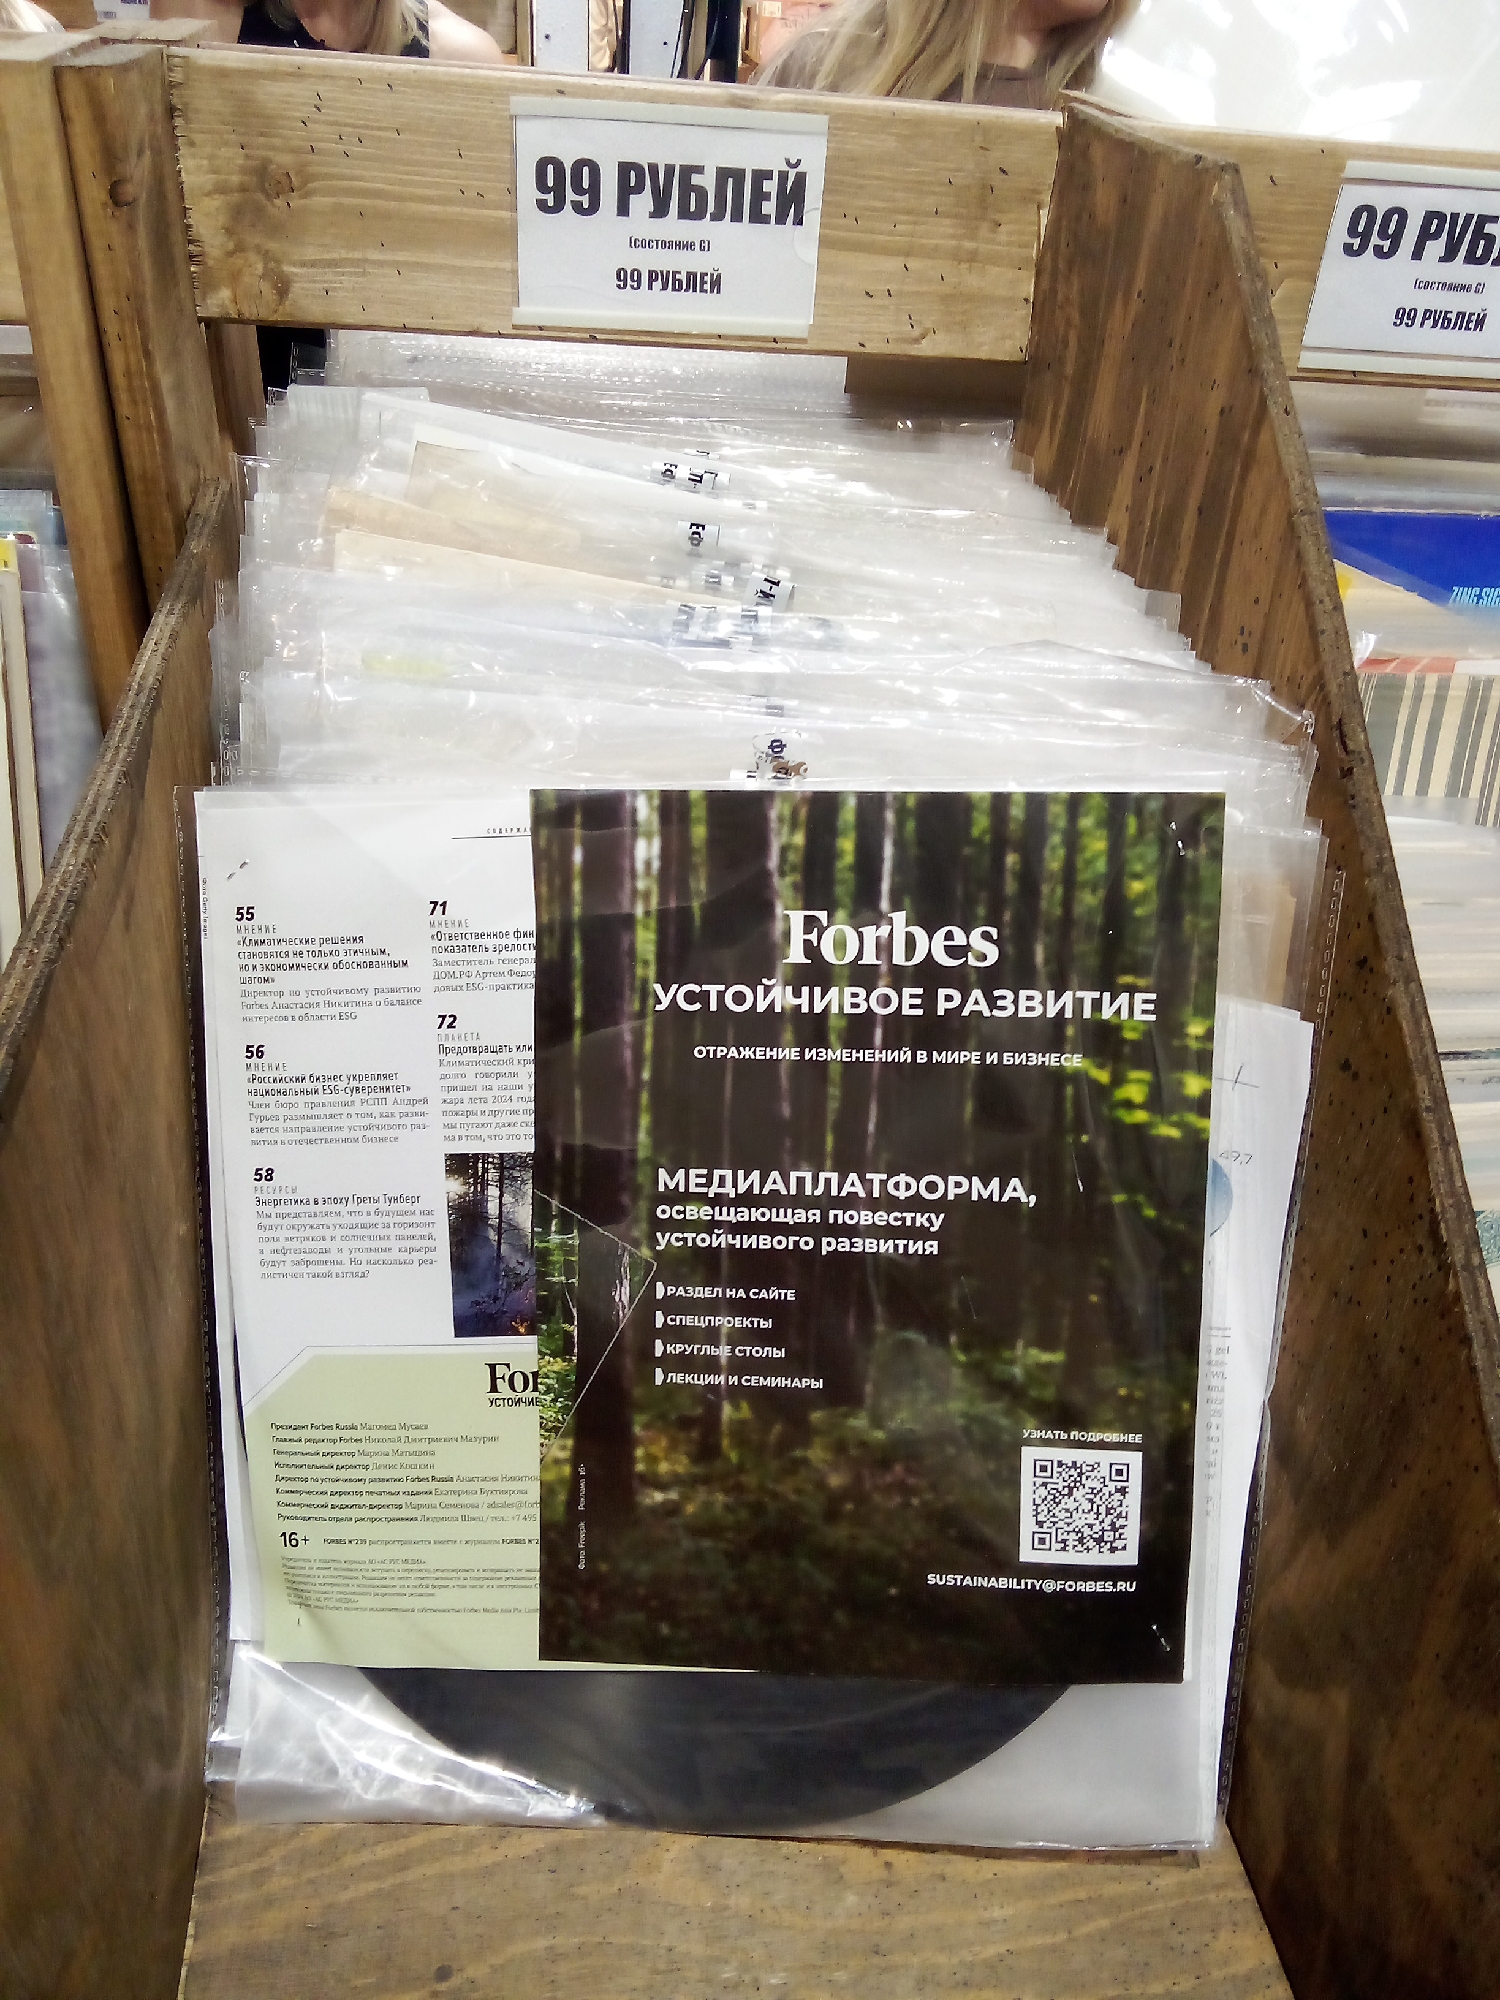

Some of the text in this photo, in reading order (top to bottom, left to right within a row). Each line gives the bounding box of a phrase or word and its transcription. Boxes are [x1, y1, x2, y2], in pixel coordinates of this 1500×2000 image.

[534, 155, 808, 227] 99 РУБЛЕЙ
[1342, 204, 1500, 267] 99 РУБ
[615, 267, 722, 295] 99 РУБЛЕЙ
[1392, 307, 1487, 332] 99 РУБЛЕЙ
[486, 827, 531, 835] СОДЕРЖА
[235, 906, 255, 922] 55
[428, 900, 448, 916] 71
[236, 924, 277, 934] МНЕНИЕ
[429, 918, 469, 929] МНЕНИЕ
[237, 934, 364, 949] «Климатические решения
[430, 929, 510, 942] «Ответственное
[782, 909, 1001, 969] Forbes
[237, 948, 390, 960] становятся не только этичным,
[431, 944, 489, 954] показатель
[238, 959, 409, 972] но и экономически обоснованным
[432, 958, 494, 967] Заместитель
[239, 975, 275, 985] шагом»
[433, 971, 473, 980] ДОМ.РФ
[475, 970, 506, 981] Артем
[240, 985, 422, 999] Директор по устойчивому развитию
[433, 985, 464, 993] довых
[241, 1001, 269, 1010] Forbes
[271, 1001, 320, 1010] Анастасия
[323, 999, 373, 1008] Никитина
[383, 997, 422, 1006] балансе
[652, 978, 1158, 1022] УСТОЙЧИВОЕ РАЗВИТИЕ
[242, 1014, 289, 1024] интересов
[298, 1012, 337, 1022] области
[338, 1011, 358, 1020] ESG
[437, 1014, 457, 1030] 72
[437, 1032, 481, 1042] ПЛАНЕТА
[244, 1044, 265, 1060] 56
[438, 1043, 533, 1056] Предотвращать или
[693, 1044, 1083, 1068] ОТРАЖЕНИЕ ИЗМЕНЕНИЙ В МИРЕ И БИЗНЕСЕ
[245, 1062, 288, 1072] МНЕНИЕ
[439, 1058, 514, 1068] Климатический
[246, 1072, 399, 1085] «Российский бизнес укрепляет
[474, 1072, 519, 1080] говорили
[247, 1083, 411, 1098] национальный ESG-суверенитет»
[440, 1085, 477, 1094] пришел
[248, 1097, 429, 1110] Член бюро правления РСПП Андрей
[440, 1097, 464, 1106] жара
[468, 1096, 488, 1104] лета
[491, 1094, 513, 1104] 2024
[248, 1112, 280, 1123] Гурьев
[282, 1112, 343, 1122] размышляет
[355, 1112, 377, 1121] том,
[250, 1125, 280, 1134] вается
[282, 1124, 345, 1134] направление
[347, 1122, 408, 1134] устойчивого
[250, 1138, 278, 1146] вития
[287, 1135, 359, 1145] отечественном
[361, 1134, 399, 1144] бизнесе
[253, 1167, 275, 1182] 58
[253, 1186, 298, 1195] РЕСУРСЫ
[656, 1167, 1038, 1208] МЕДИАПЛАТФОРМА,
[255, 1193, 421, 1208] Энергетика в эпоху Греты Тунберг
[256, 1210, 272, 1219] Мы
[275, 1209, 345, 1220] представляем,
[347, 1210, 364, 1218] что
[374, 1208, 416, 1218] будущем
[419, 1208, 435, 1216] нас
[656, 1203, 945, 1233] освещающая повестку
[655, 1228, 939, 1256] устойчивого развития
[306, 1269, 333, 1279] такой
[335, 1269, 370, 1279] взгляд?
[666, 1285, 796, 1301] РАЗДЕЛ НА САЙТЕ
[666, 1314, 773, 1329] СПЕЦПРОЕКТЫ
[666, 1343, 786, 1359] КРУГЛЫЕ СТОЛЫ
[665, 1371, 824, 1390] ЛЕКЦИИ И СЕМИНАРЫ
[270, 1422, 309, 1431] Президент
[304, 1437, 337, 1445] редактор
[1022, 1428, 1143, 1444] УЗНАТЬ ПОДРОБНЕЕ
[577, 1478, 586, 1511] Реклама
[279, 1531, 310, 1548] 16+
[577, 1521, 587, 1548] Freepik
[927, 1573, 1138, 1593] SUSTAINABILITY@FORBES.RU
